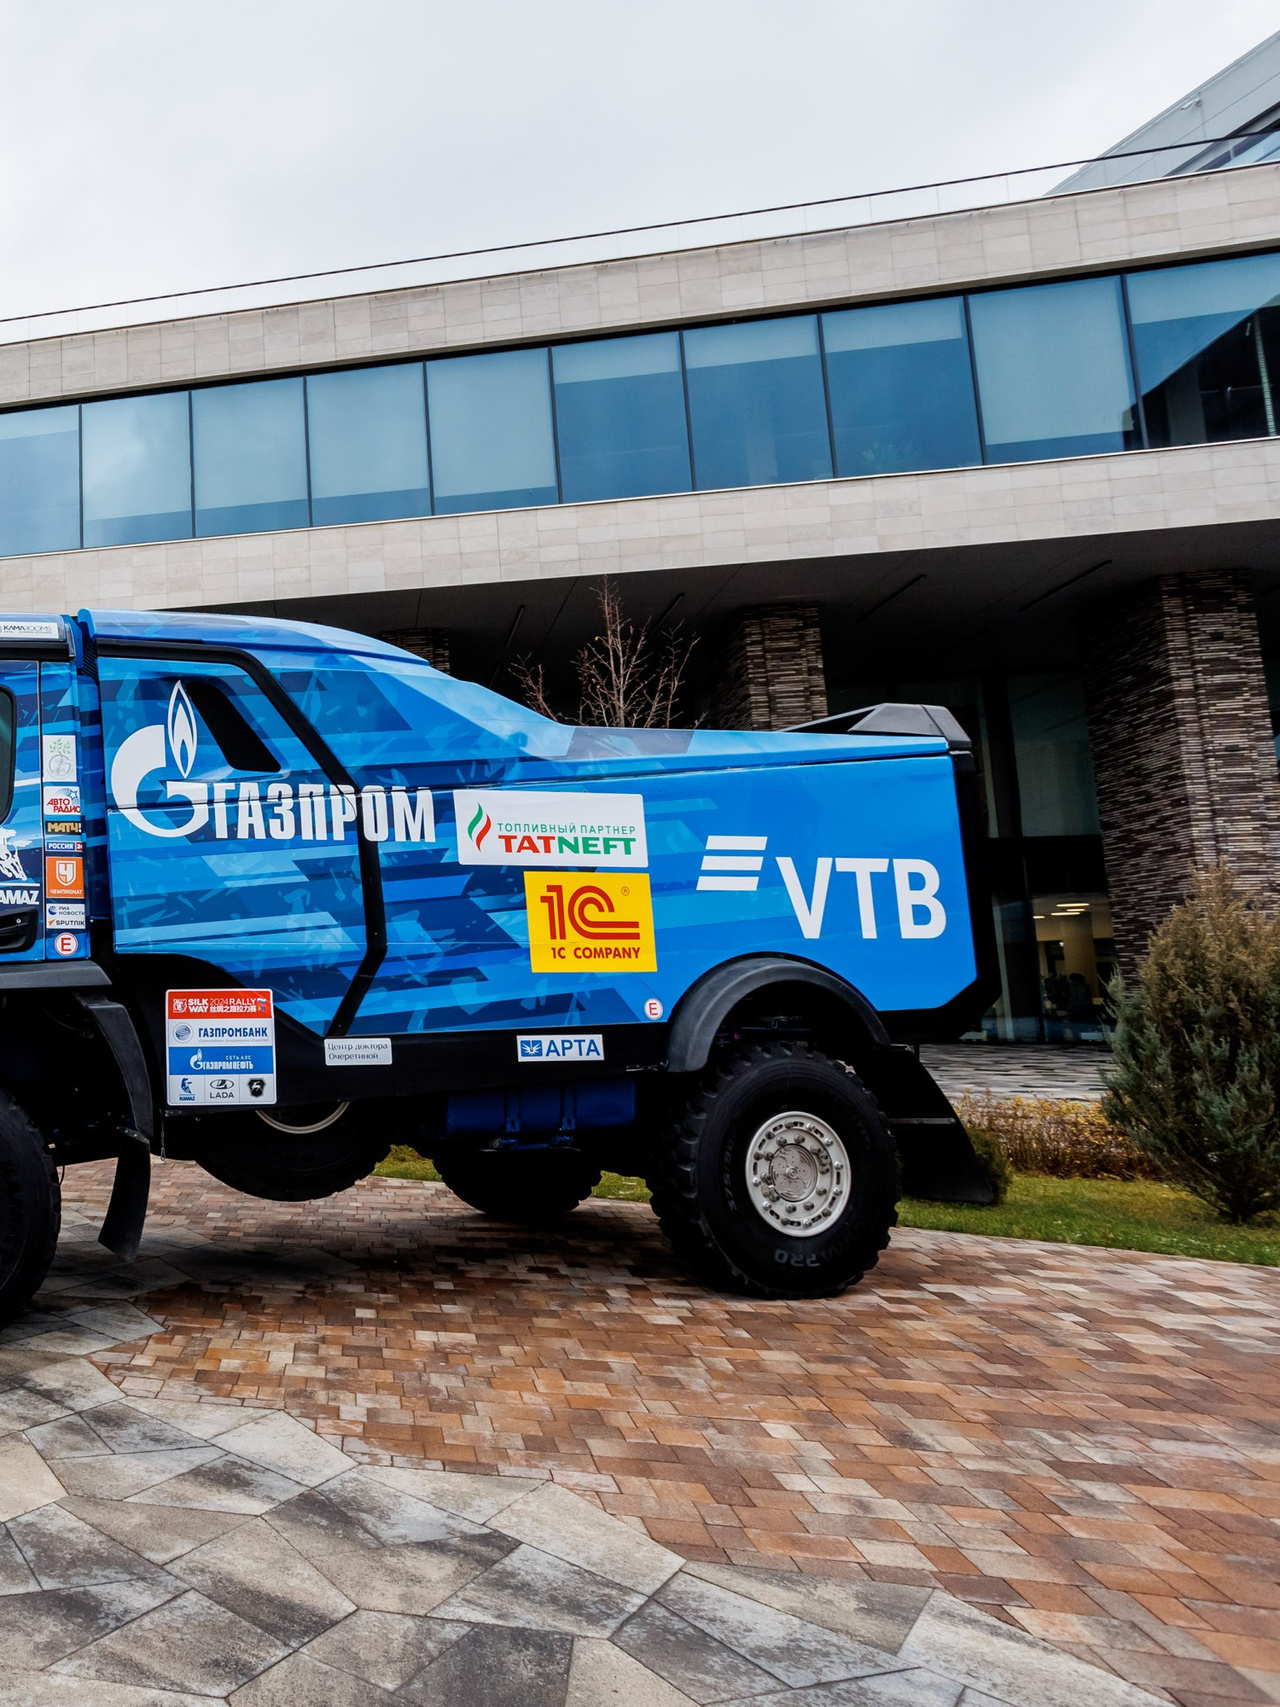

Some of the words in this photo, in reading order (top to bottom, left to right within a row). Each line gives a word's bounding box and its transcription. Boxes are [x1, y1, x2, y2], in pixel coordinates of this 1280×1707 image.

[47, 798, 70, 806] АВТО
[212, 782, 436, 843] ГАЗПРОМ
[497, 822, 577, 834] ТОПЛИВНЫЙ
[580, 825, 636, 835] ПАРТНЕР
[498, 834, 636, 855] TATNEFT
[776, 856, 947, 940] VTB
[60, 937, 72, 952] E
[573, 947, 641, 959] COMPANY
[648, 1002, 658, 1016] E
[198, 1027, 268, 1037] ГАЗПРОМБАНК
[327, 1043, 353, 1051] Центр
[355, 1043, 388, 1051] доктора
[328, 1052, 379, 1061] Очеретиной
[202, 1060, 254, 1070] ГАЗПРОМНЕФТЬ
